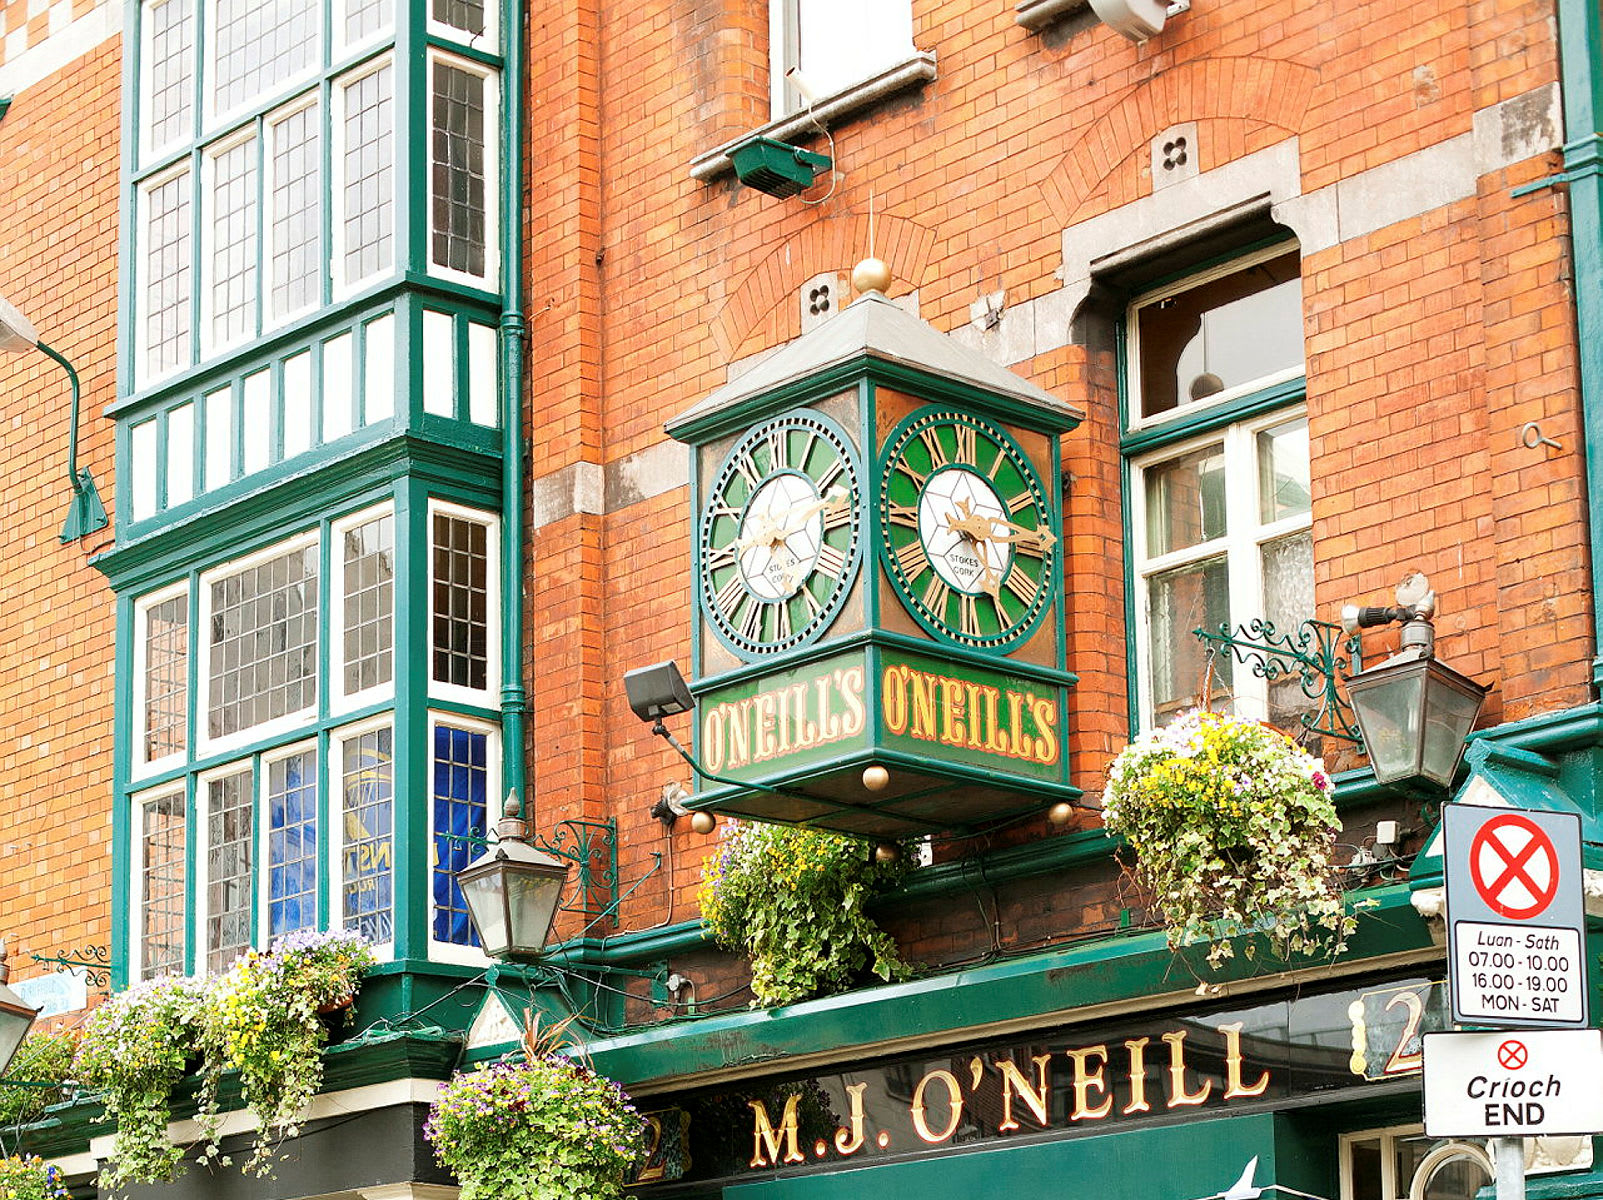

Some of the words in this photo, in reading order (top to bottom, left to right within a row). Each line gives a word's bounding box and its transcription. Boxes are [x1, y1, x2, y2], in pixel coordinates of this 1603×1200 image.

[950, 553, 979, 568] STOKES
[704, 664, 866, 774] O'NEILL'S
[882, 664, 1060, 765] O'NEILL'S
[1477, 931, 1513, 948] Luan
[1525, 934, 1560, 950] Sath
[1469, 951, 1515, 969] 07.00
[1527, 955, 1569, 972] 10.00
[1473, 973, 1515, 990] 16.00
[1527, 976, 1568, 993] 19.00
[1481, 994, 1519, 1011] MON
[1532, 997, 1560, 1013] SAT
[1384, 991, 1423, 1074] 2
[748, 1081, 891, 1168] M.J.
[910, 1020, 1271, 1143] O'NEILL
[1485, 1102, 1545, 1126] END
